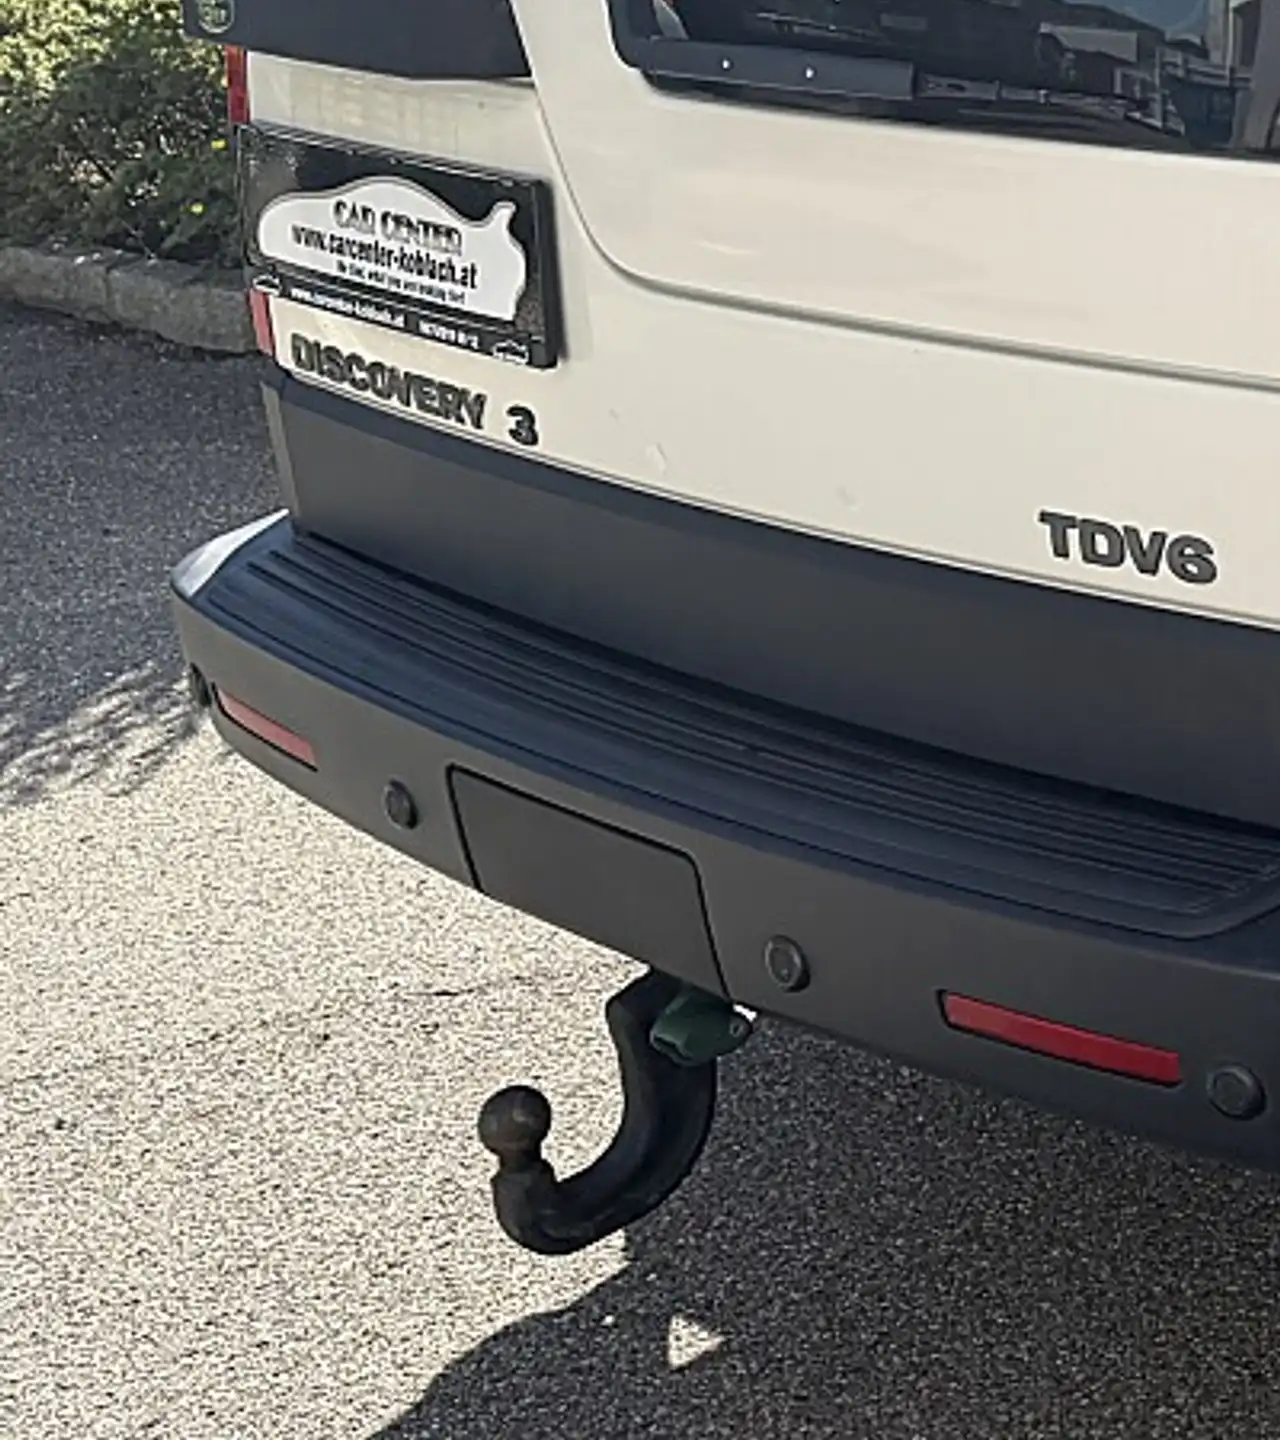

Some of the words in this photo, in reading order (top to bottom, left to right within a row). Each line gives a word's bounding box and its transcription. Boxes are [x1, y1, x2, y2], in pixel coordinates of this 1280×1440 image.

[381, 211, 463, 256] CENTER
[291, 332, 487, 430] DISCOVERY
[506, 405, 539, 446] 3
[1038, 509, 1218, 585] TDV6
